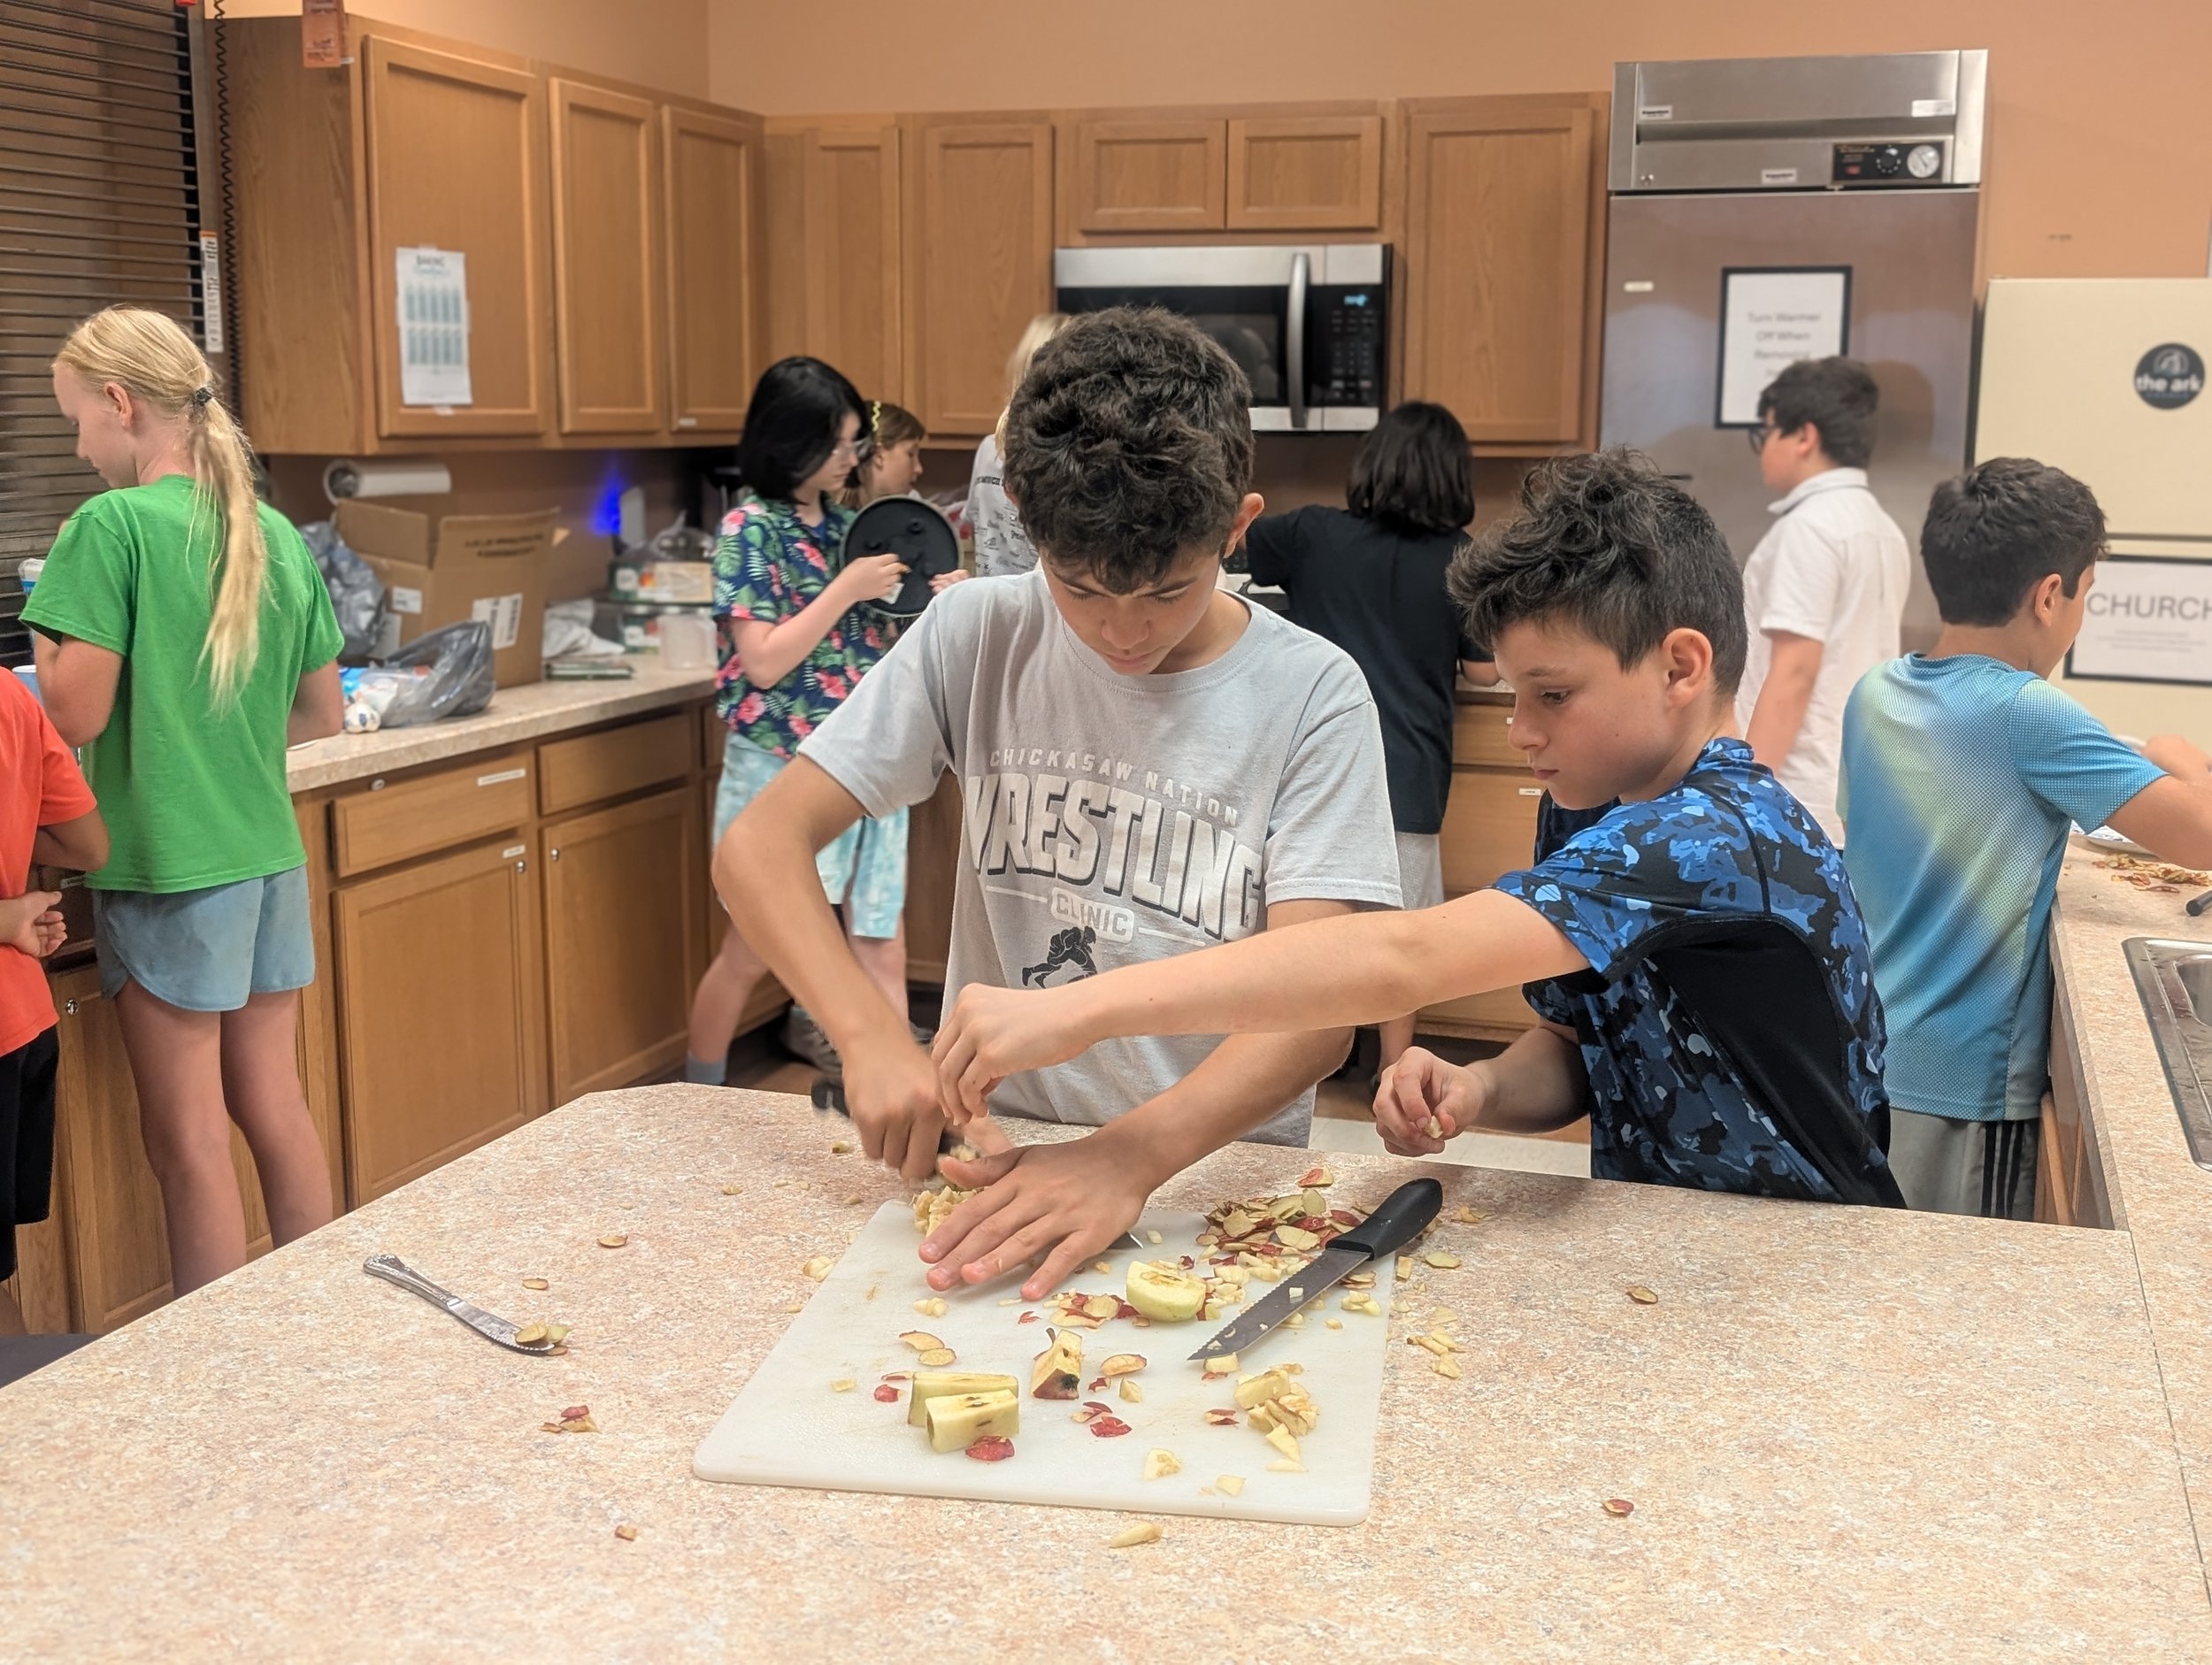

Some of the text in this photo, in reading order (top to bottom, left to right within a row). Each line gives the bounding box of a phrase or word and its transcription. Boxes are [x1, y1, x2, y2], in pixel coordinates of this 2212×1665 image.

[2135, 372, 2200, 391] the ark
[989, 748, 1238, 827] CHICKASAW NATION
[1054, 893, 1128, 937] CLINIC
